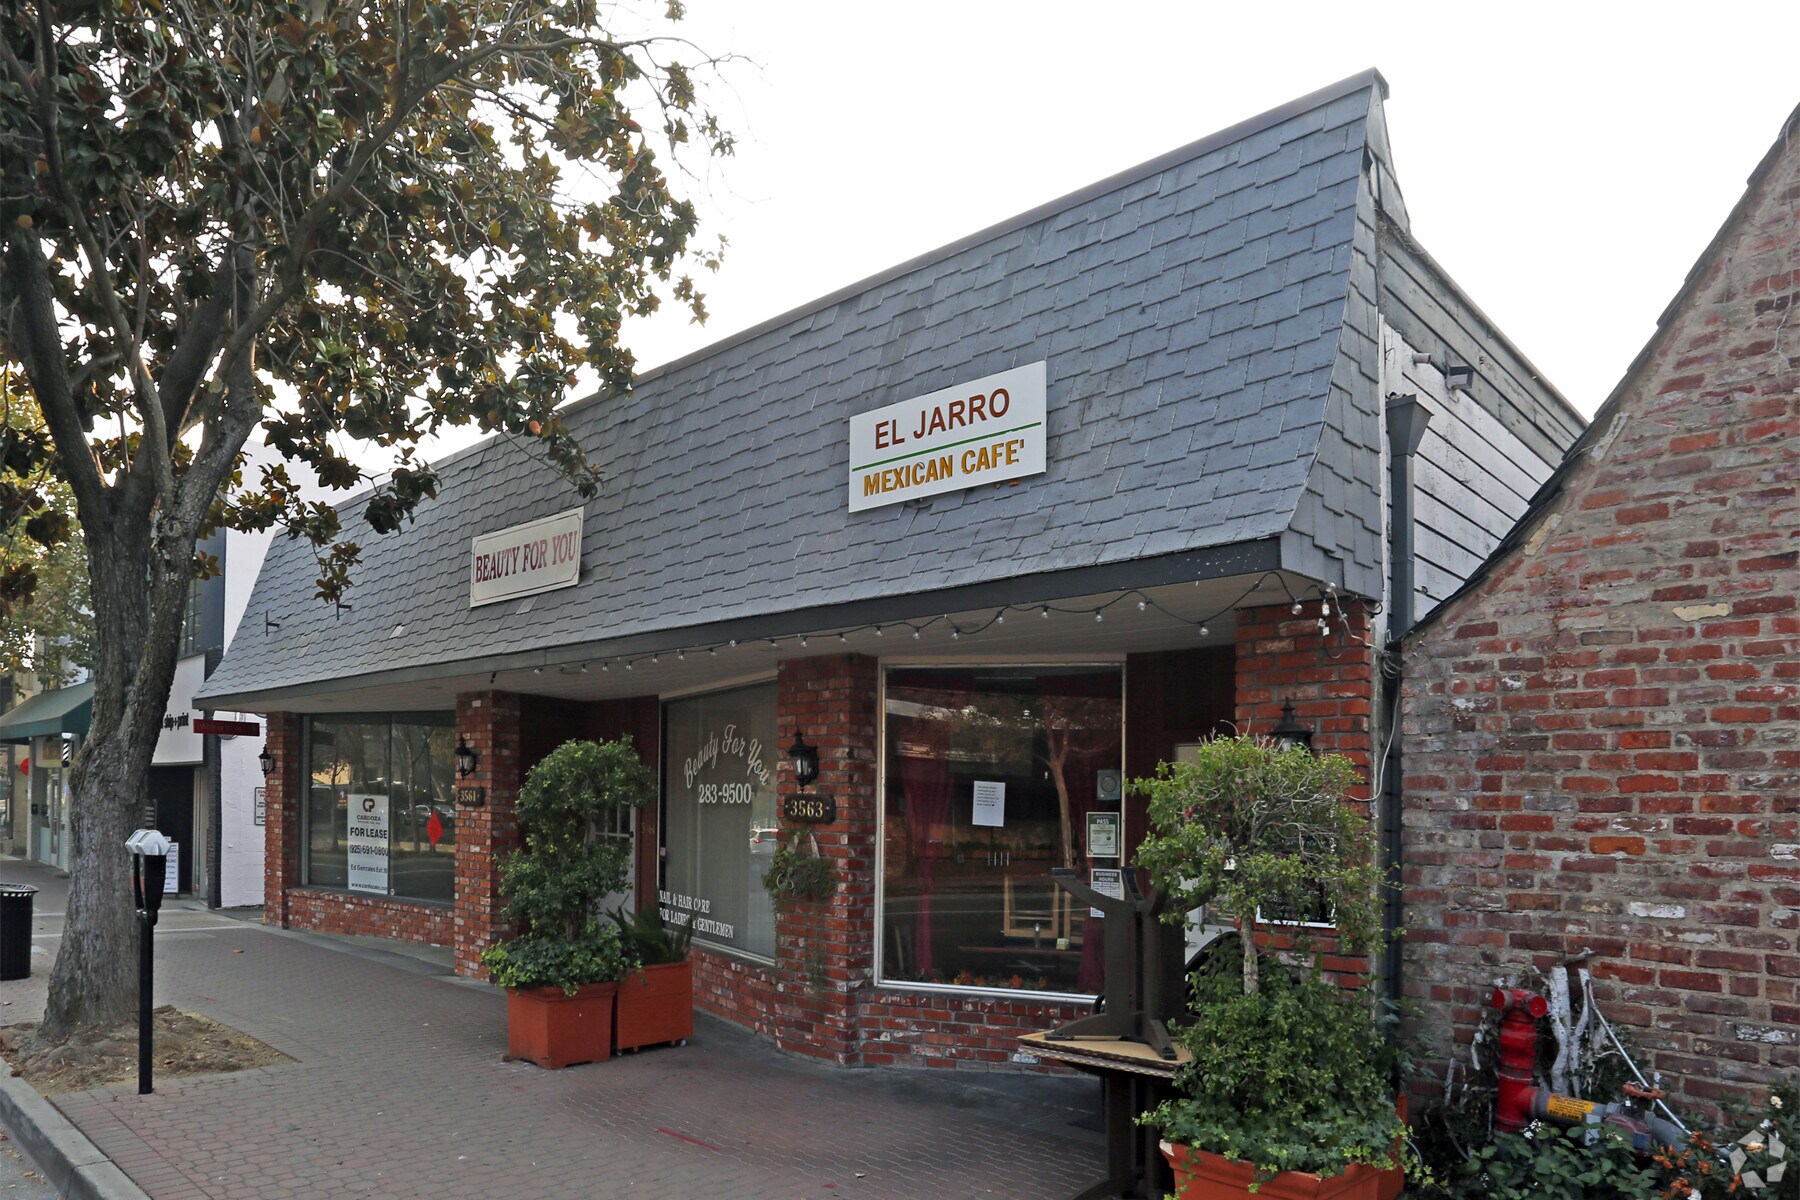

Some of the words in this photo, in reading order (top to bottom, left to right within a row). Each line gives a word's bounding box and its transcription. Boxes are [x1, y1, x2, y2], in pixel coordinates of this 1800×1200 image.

[875, 418, 905, 450] EL
[913, 388, 1010, 440] JARRO
[863, 455, 953, 497] MEXICAN
[475, 546, 520, 583] BEAUTY
[522, 538, 548, 573] FOR
[552, 530, 578, 566] YOU
[684, 731, 719, 789] Beauty
[722, 724, 746, 757] For
[747, 738, 770, 786] You
[460, 790, 476, 802] 3561
[699, 783, 752, 804] 283-9500
[790, 800, 823, 818] 3563
[350, 827, 365, 837] FOR
[366, 828, 388, 839] LEASE
[659, 890, 672, 905] NAIL
[673, 893, 678, 906] &
[678, 894, 693, 910] HAIR
[693, 897, 711, 914] CARE
[697, 916, 734, 939] GENTLEMEN
